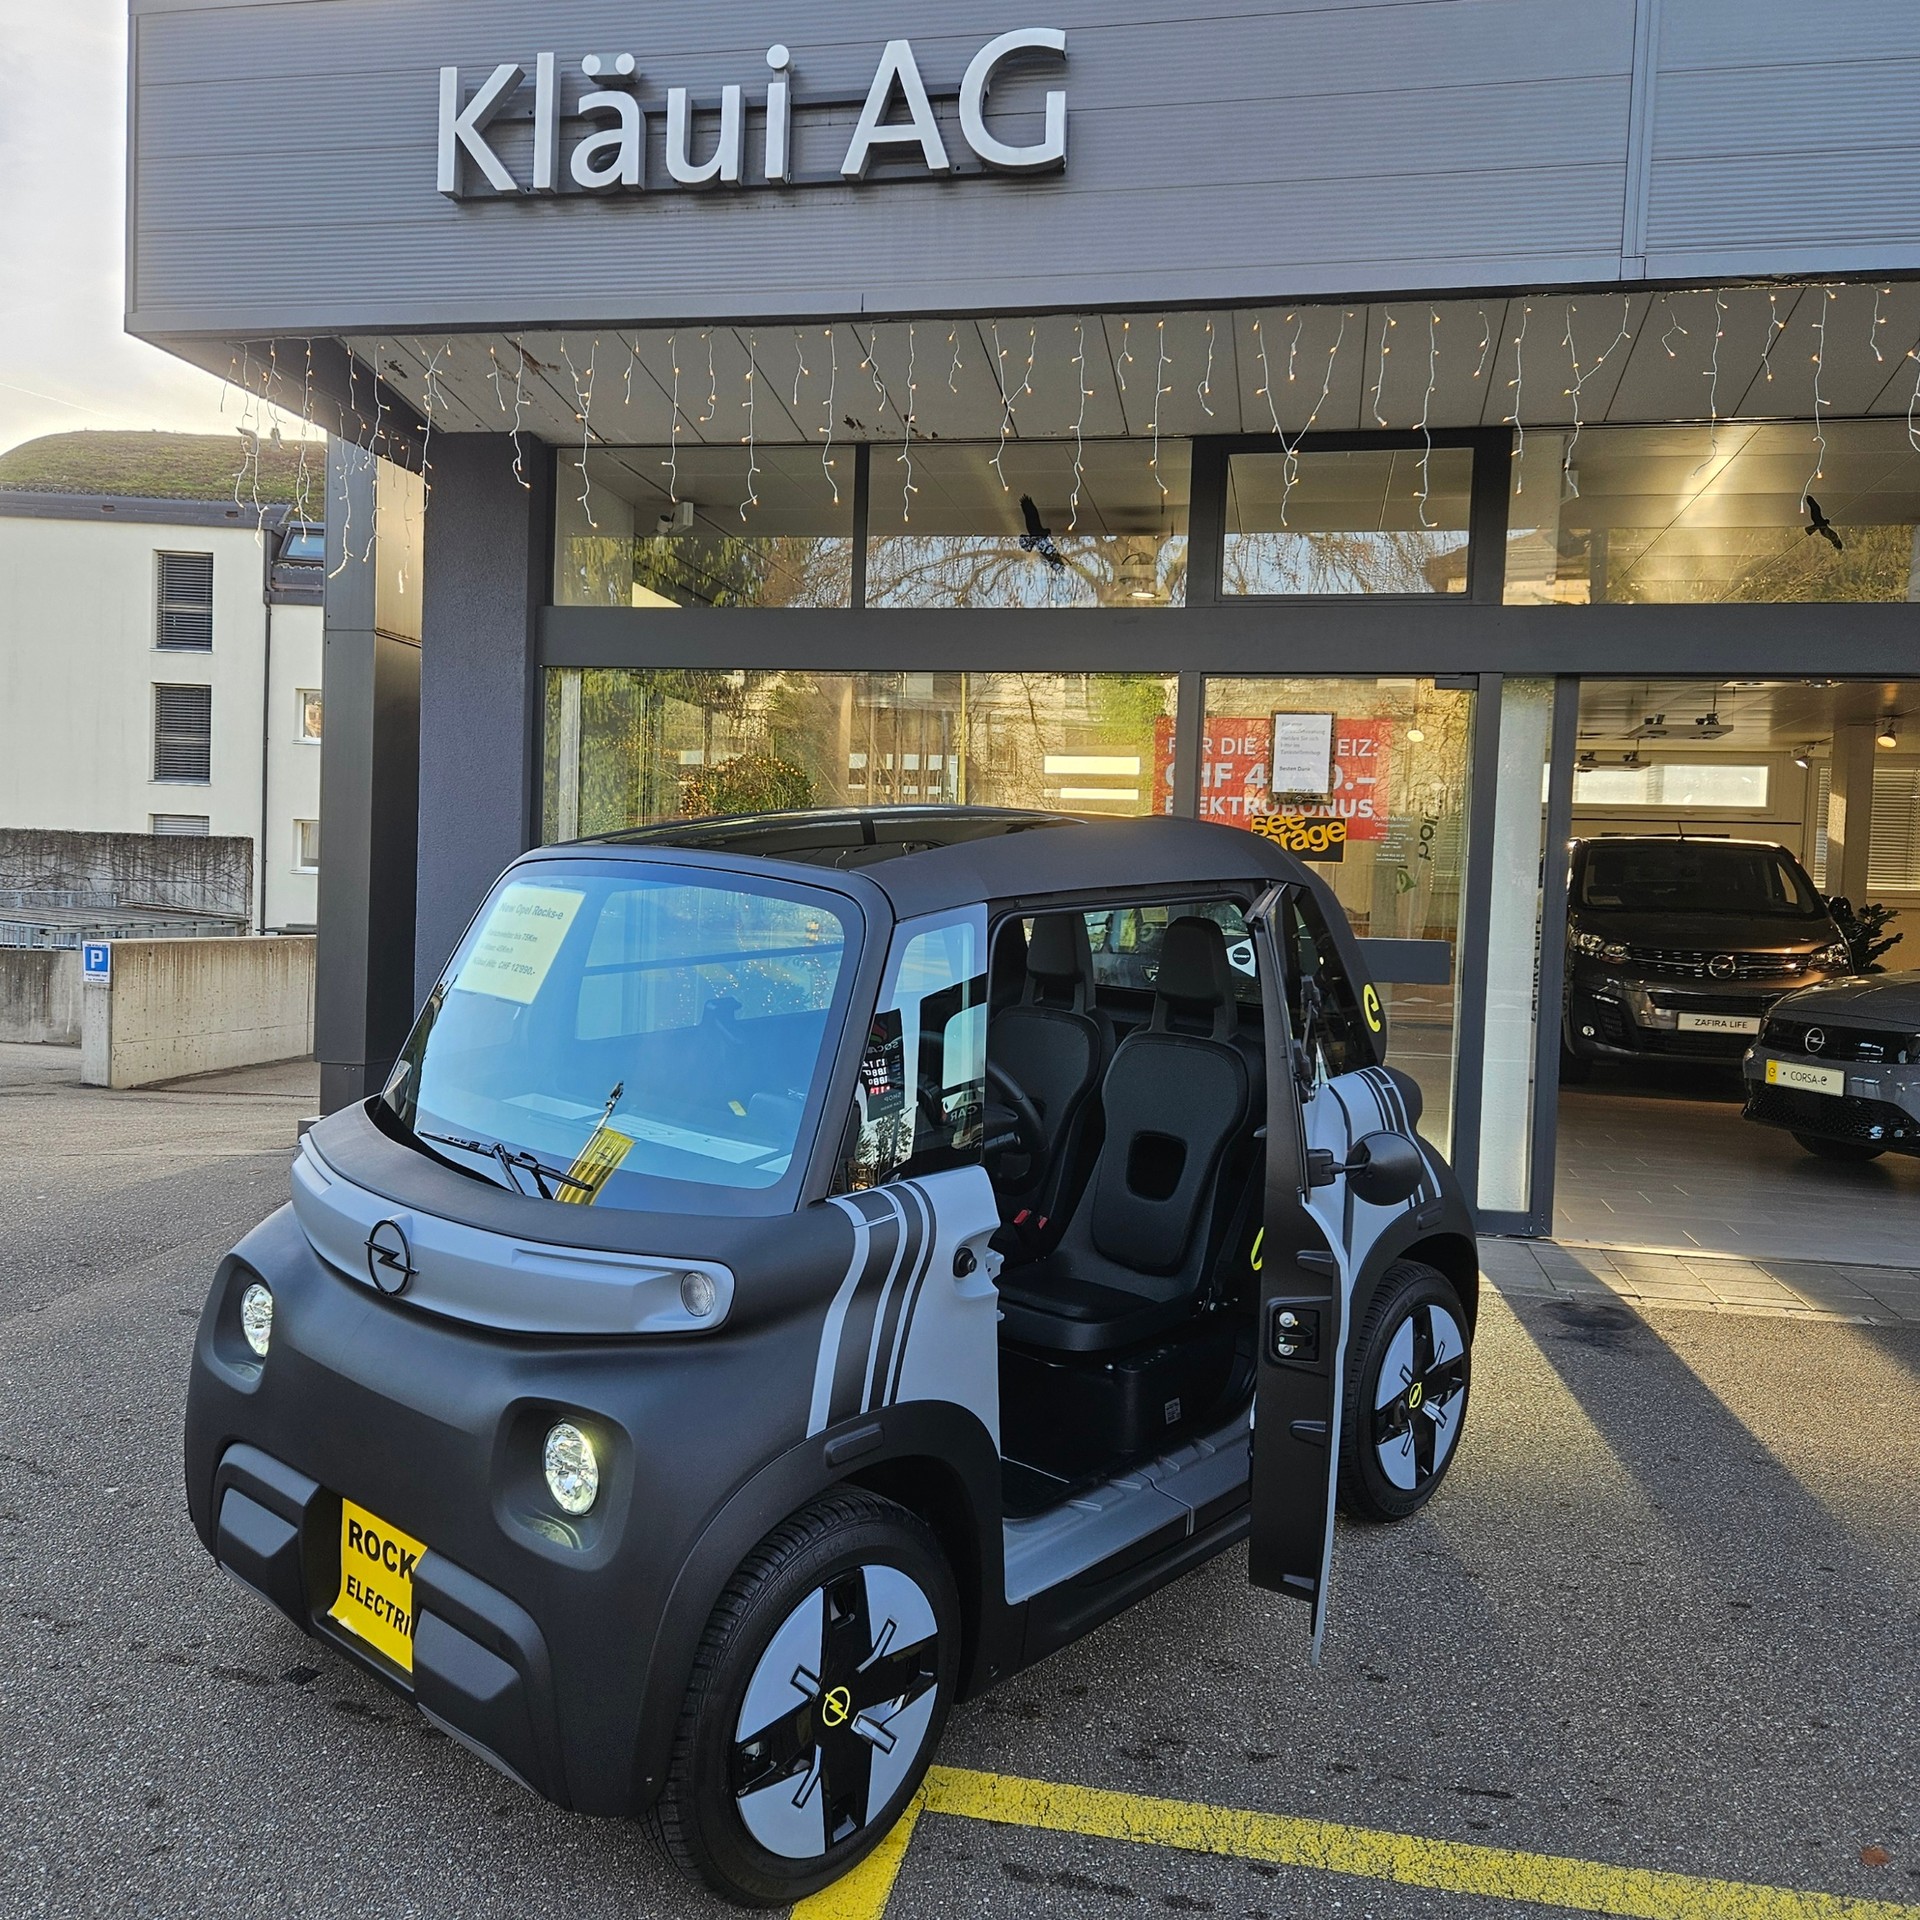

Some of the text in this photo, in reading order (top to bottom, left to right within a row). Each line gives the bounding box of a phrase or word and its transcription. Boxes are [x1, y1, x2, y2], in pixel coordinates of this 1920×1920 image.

[437, 27, 1067, 196] Kläui AG
[1168, 737, 1213, 755] FR
[1221, 737, 1258, 755] DIE
[1165, 796, 1375, 818] EEKTROBONUS
[1266, 821, 1346, 852] rage
[532, 905, 564, 919] Rocks-e
[91, 950, 103, 969] P
[1694, 1018, 1748, 1029] ZAFIRA LIFE
[1790, 1071, 1828, 1086] CORSA-e
[346, 1574, 413, 1640] ELECTRI
